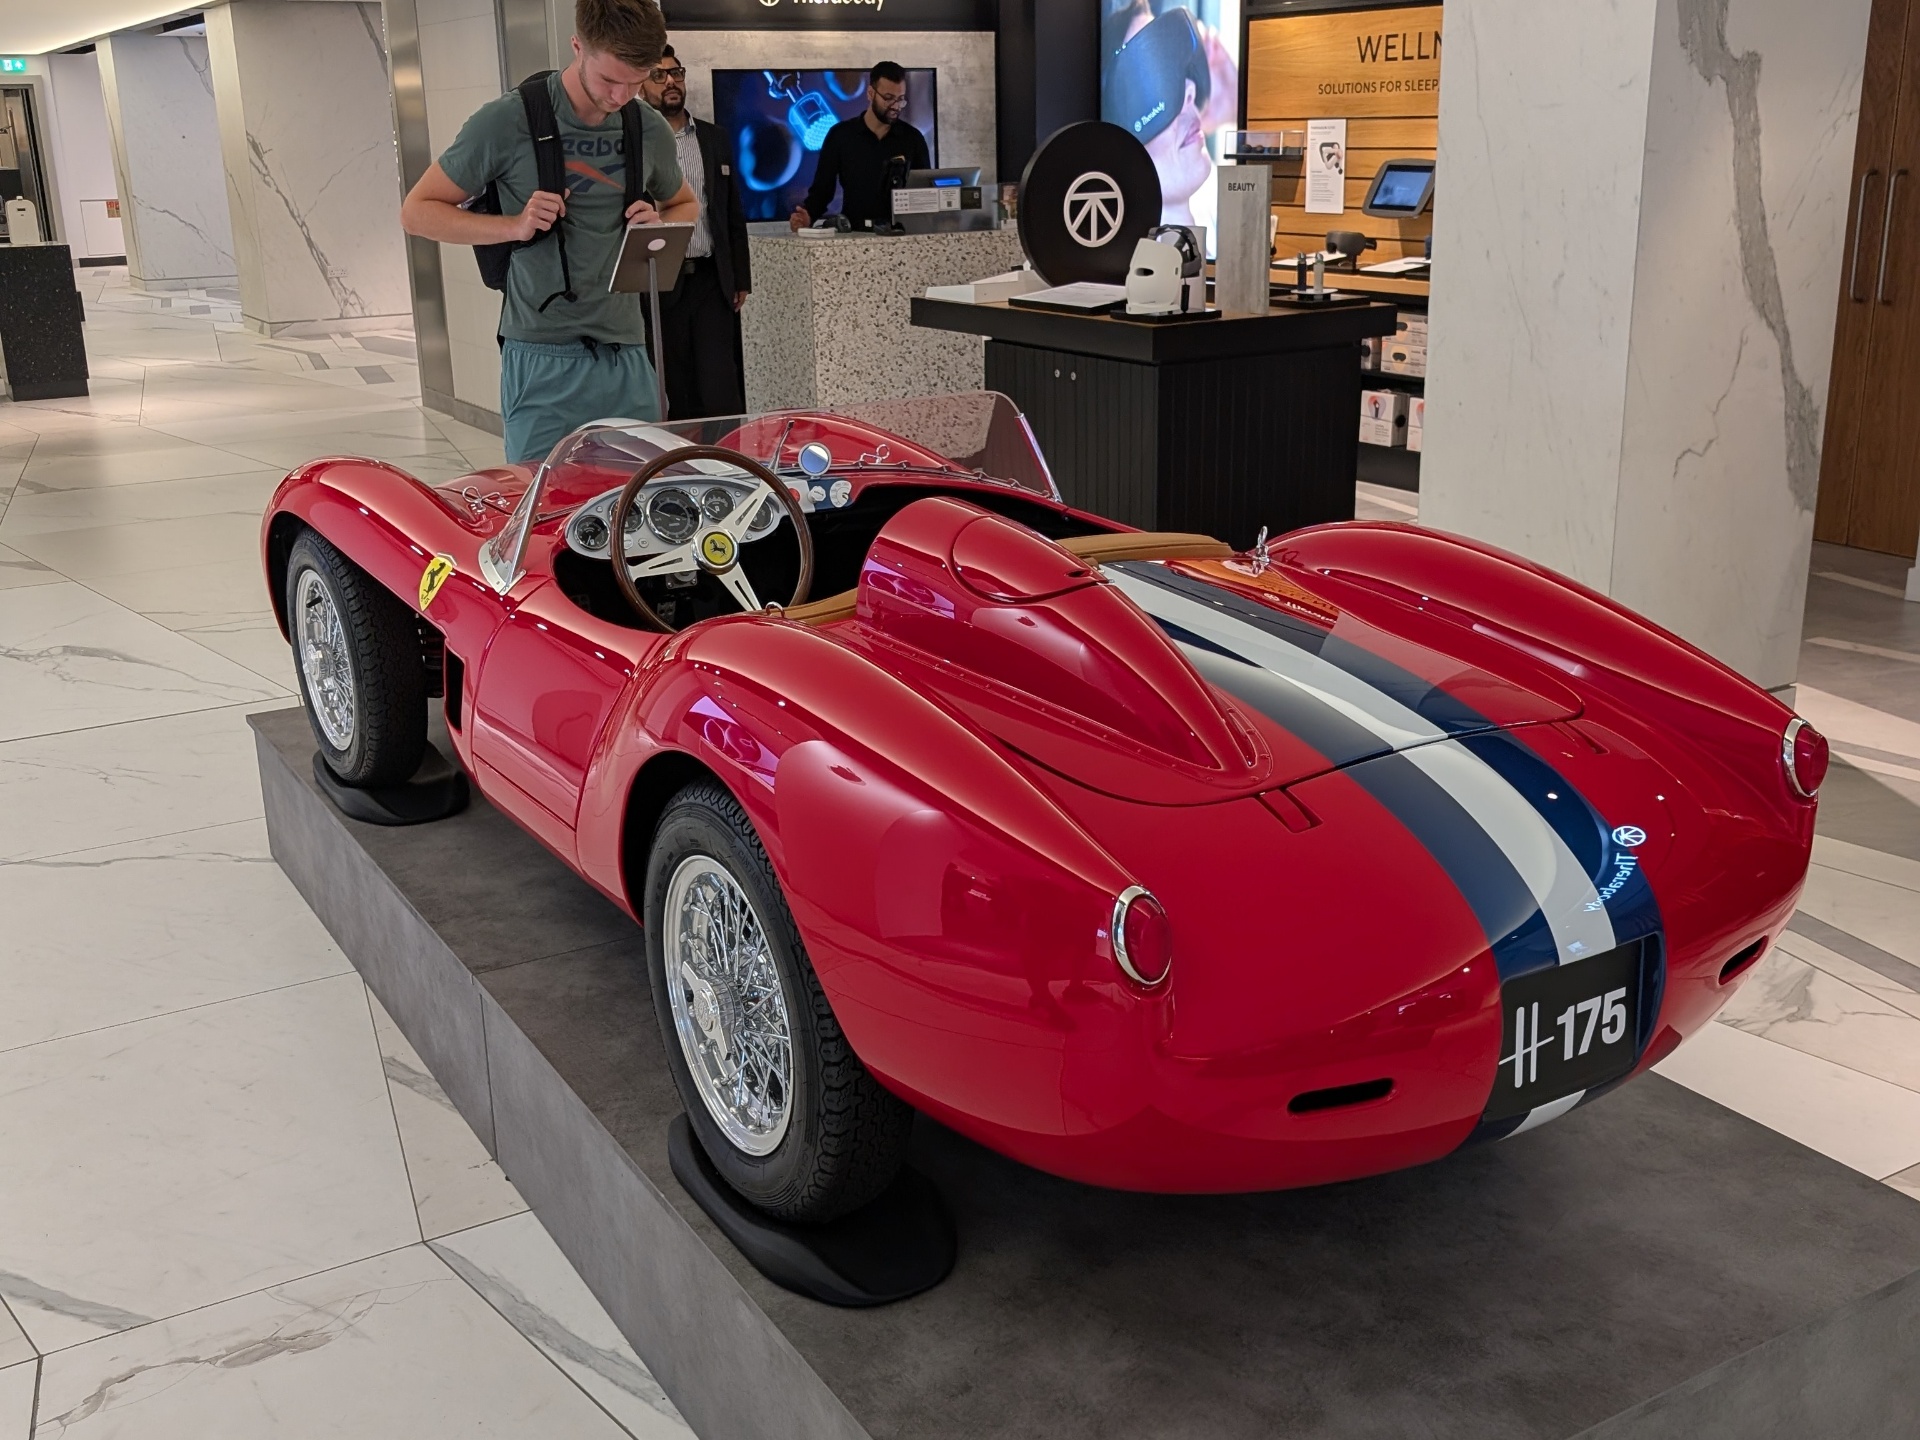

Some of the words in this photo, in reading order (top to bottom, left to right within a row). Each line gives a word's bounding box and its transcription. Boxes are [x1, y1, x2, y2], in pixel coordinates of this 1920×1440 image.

[1318, 82, 1377, 95] SOLUTIONS
[1380, 80, 1402, 93] FOR
[1227, 182, 1256, 191] BEAUTY
[1556, 986, 1627, 1062] 175
